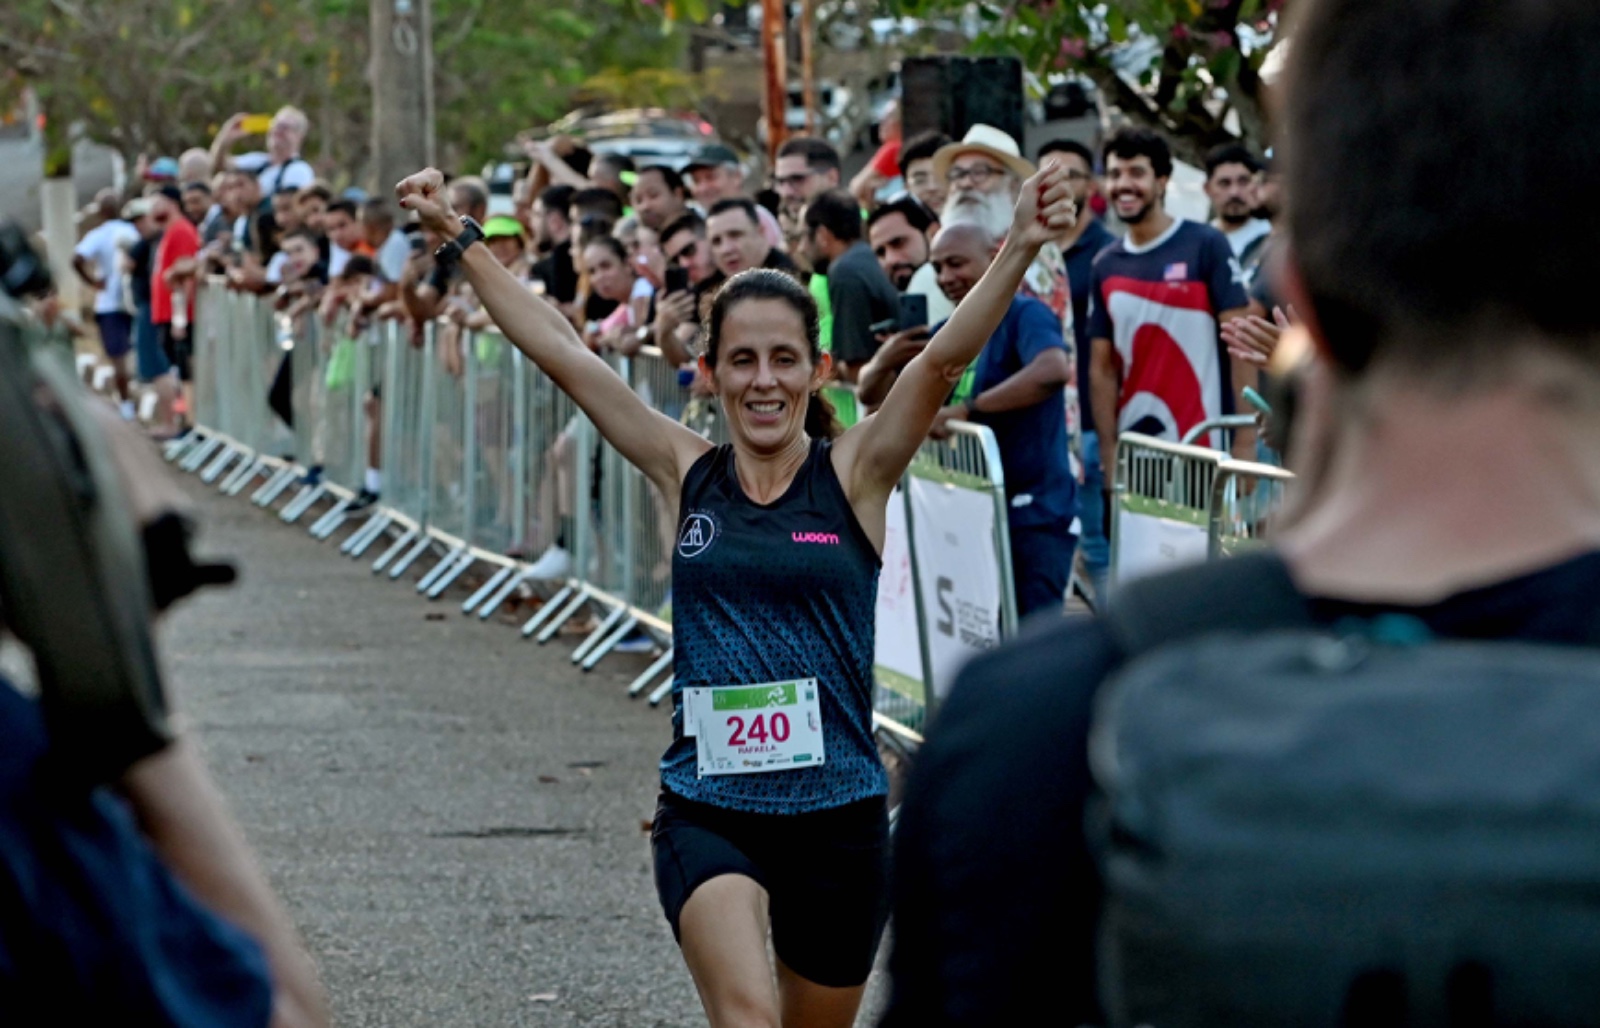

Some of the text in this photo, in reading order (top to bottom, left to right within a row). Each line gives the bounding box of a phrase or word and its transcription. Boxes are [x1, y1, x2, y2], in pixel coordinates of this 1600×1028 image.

[791, 531, 840, 545] woom
[726, 711, 791, 747] 240
[737, 744, 777, 755] RAFAELA
